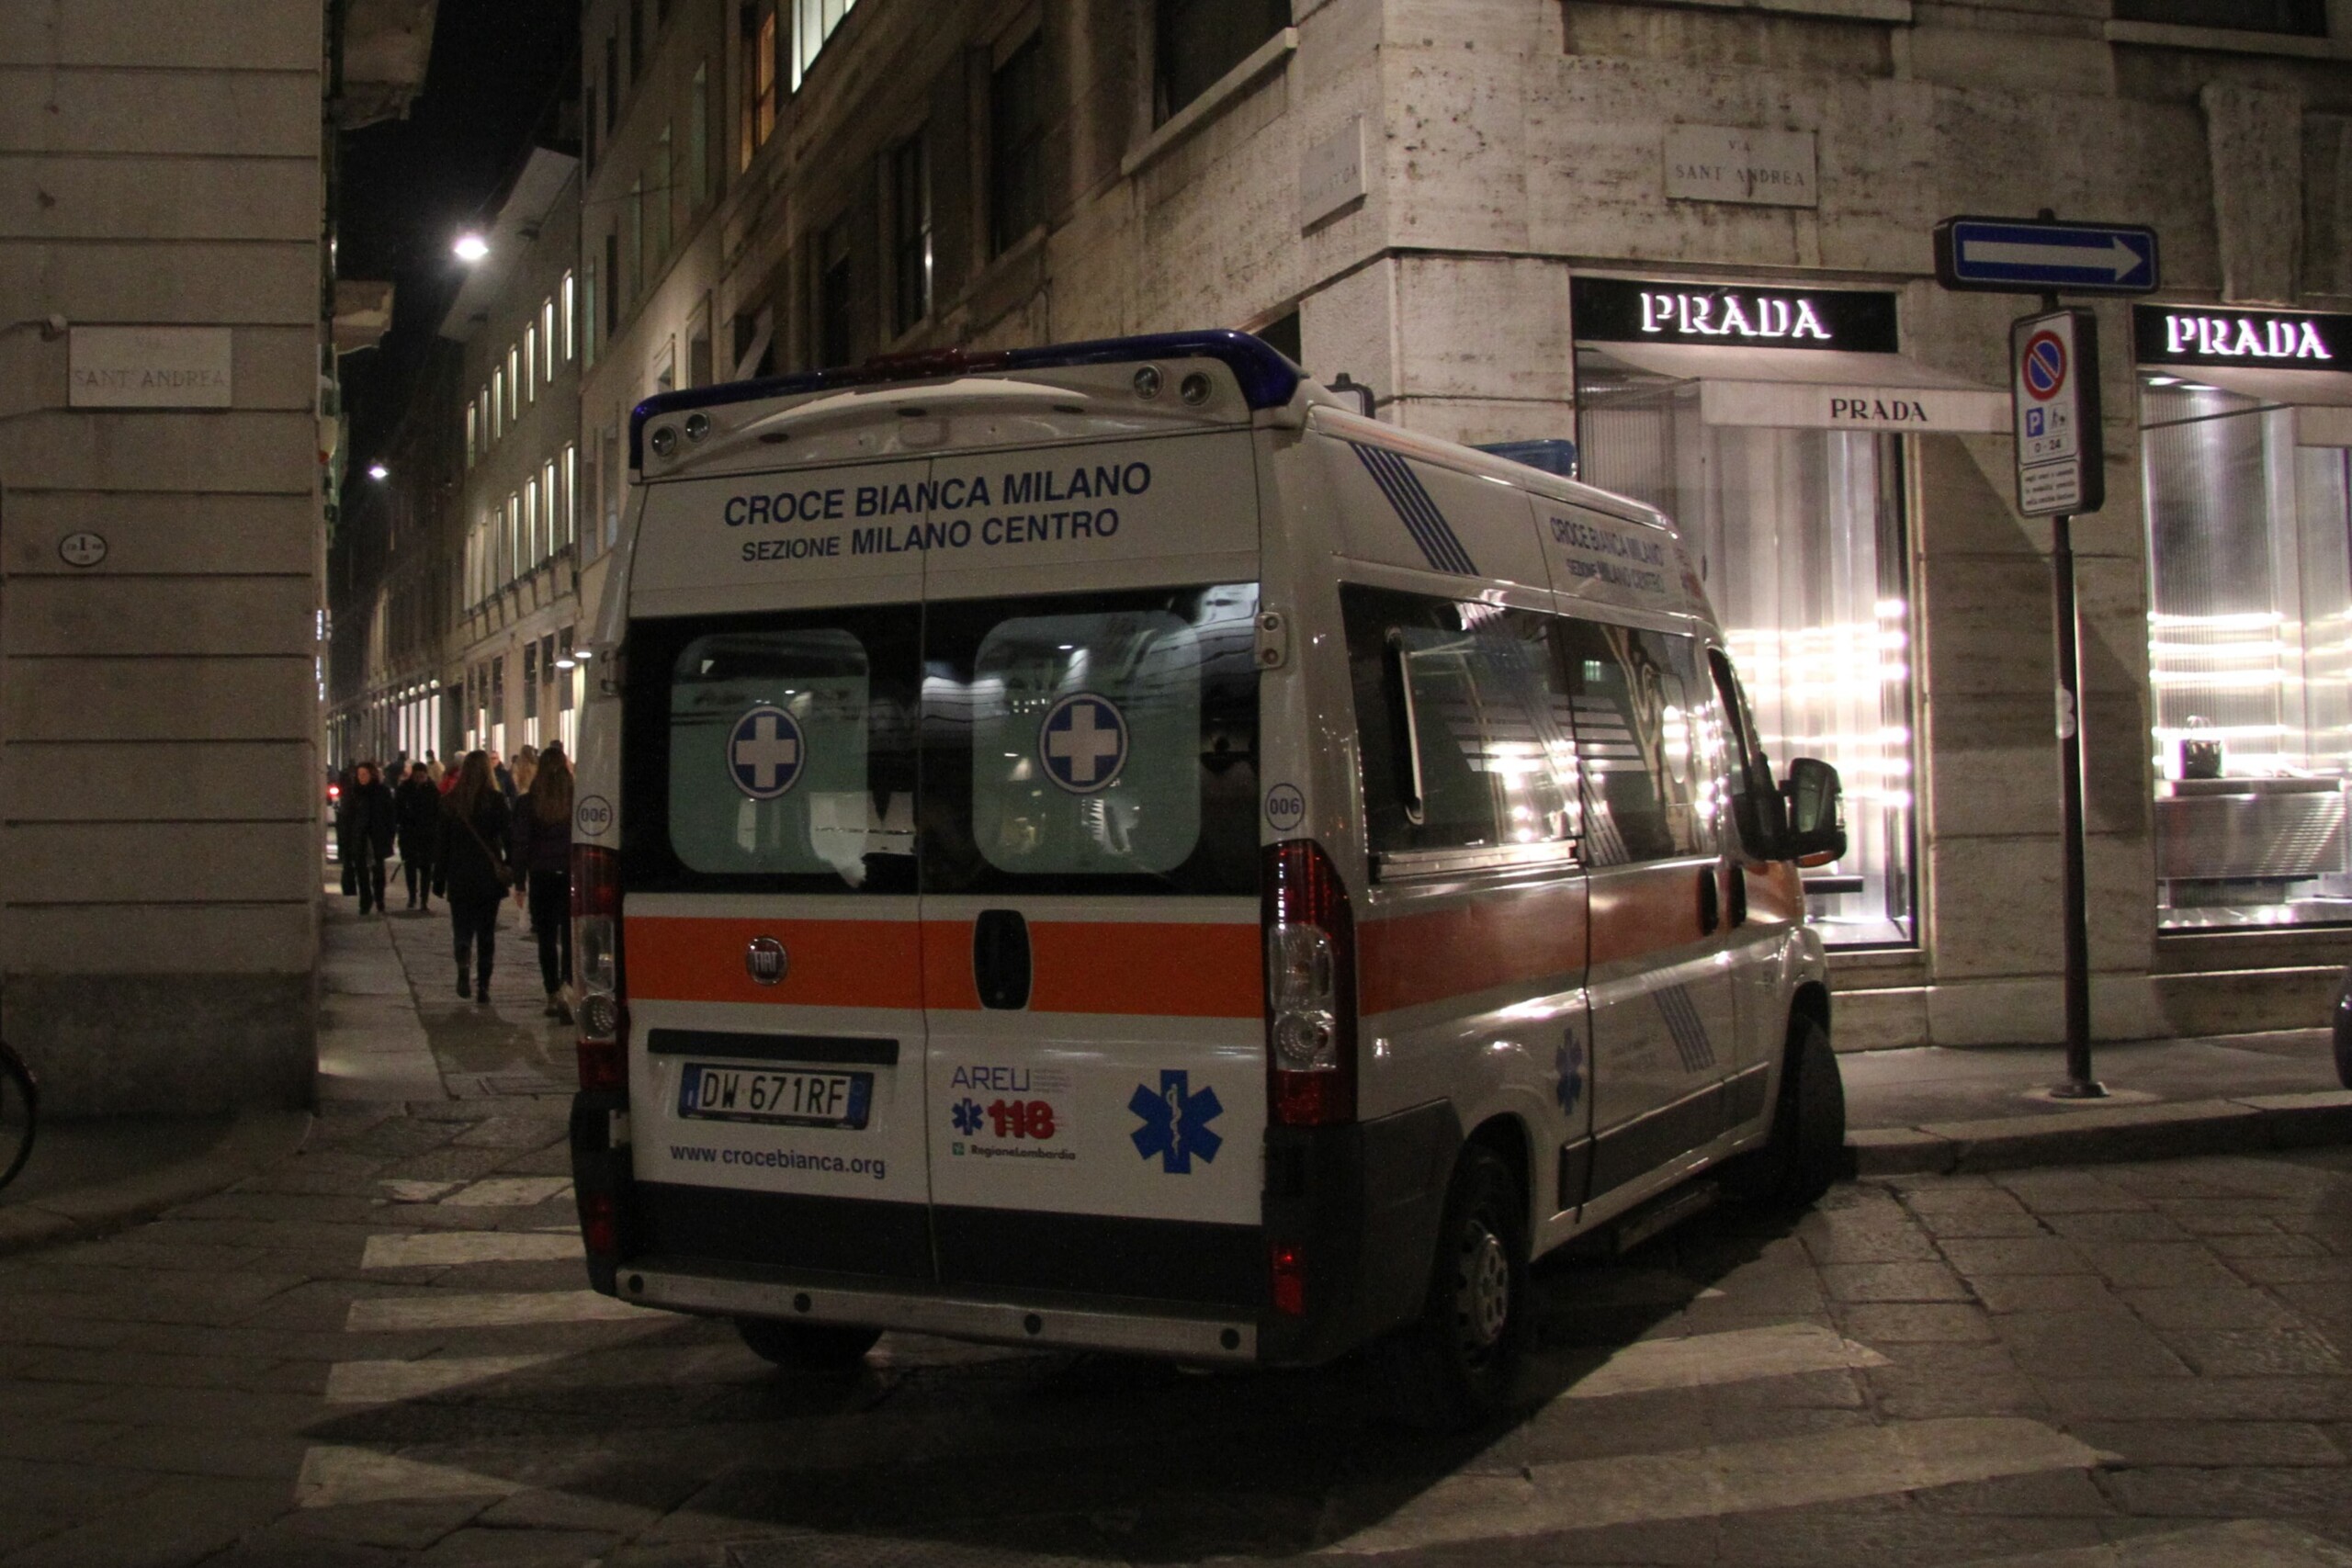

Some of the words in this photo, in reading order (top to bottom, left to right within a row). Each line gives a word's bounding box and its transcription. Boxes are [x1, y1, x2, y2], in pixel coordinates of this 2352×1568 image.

[1728, 140, 1751, 152] VA
[1736, 168, 1804, 186] ANDREA
[1640, 291, 1832, 340] PRADA
[2165, 314, 2334, 360] PRADA
[141, 369, 225, 388] ANDREA
[1830, 398, 1928, 423] PRADA
[2029, 411, 2041, 436] P
[724, 489, 845, 526] CROCE
[856, 477, 990, 517] BIANCA
[1003, 462, 1151, 504] MILANO
[741, 536, 841, 561] SEZIONE
[852, 520, 971, 555] MILANO
[981, 508, 1119, 546] CENTRO
[1550, 517, 1590, 550] CROCE
[581, 807, 607, 822] 006
[1270, 797, 1300, 815] 006
[753, 950, 778, 974] FIAT
[951, 1066, 1030, 1091] AREU
[702, 1072, 739, 1109] DW
[750, 1076, 847, 1114] 671RF
[988, 1099, 1055, 1139] 118
[971, 1145, 1076, 1159] RegioneLombardia
